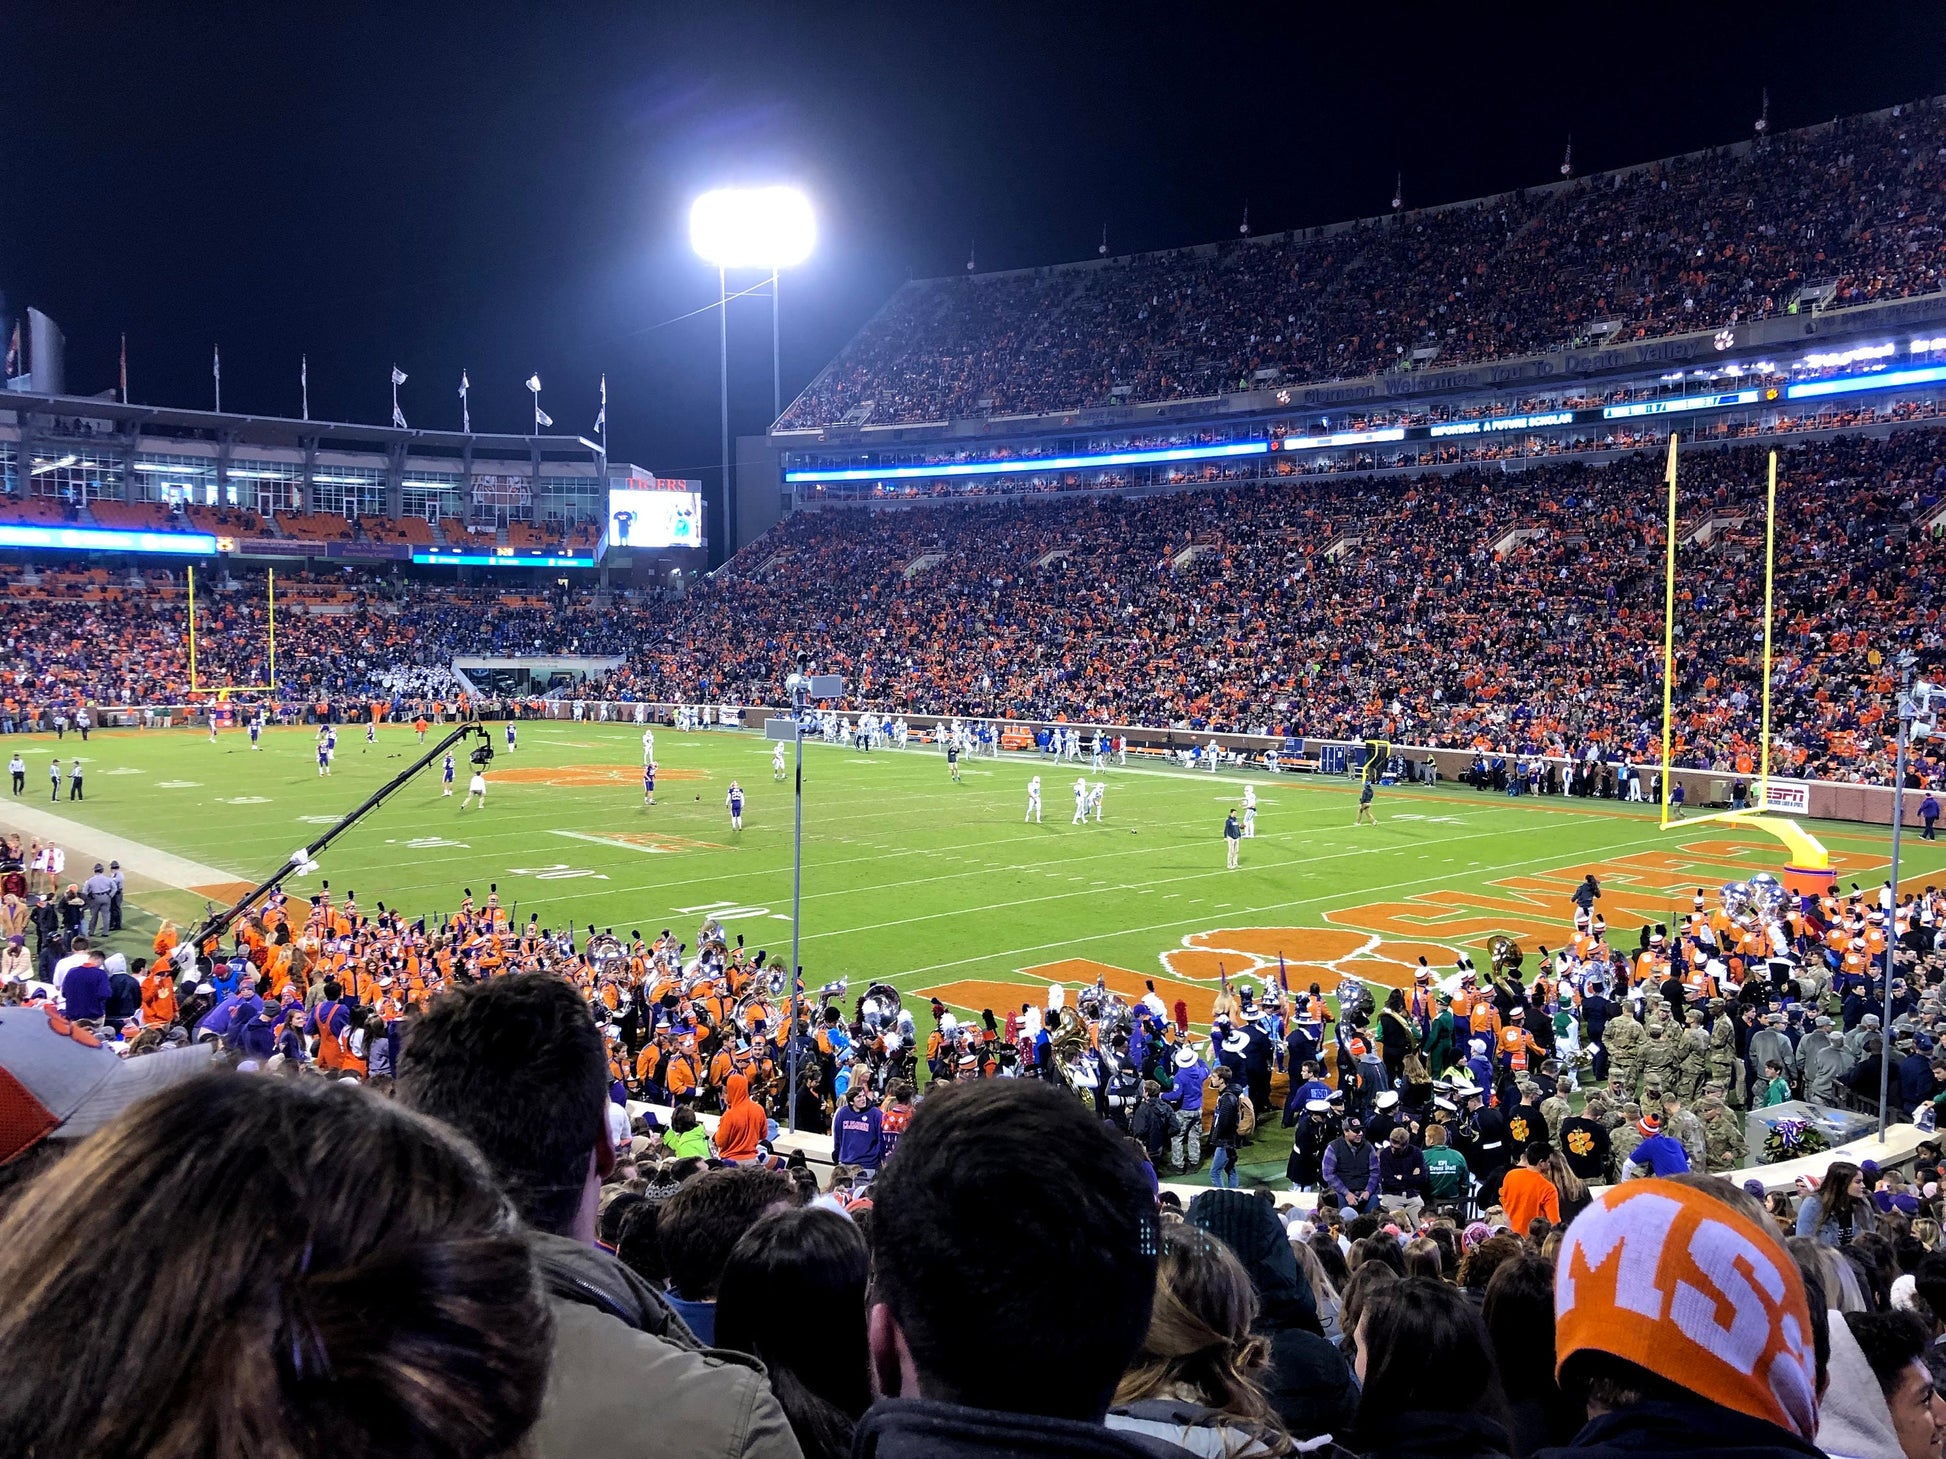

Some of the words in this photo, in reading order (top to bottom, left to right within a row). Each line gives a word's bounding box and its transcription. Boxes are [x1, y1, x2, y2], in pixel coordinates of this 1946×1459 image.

[1533, 361, 1554, 376] To
[1565, 350, 1625, 373] Death
[625, 477, 687, 491] TIGERS
[1766, 787, 1804, 802] ESPN
[669, 901, 771, 921] 10
